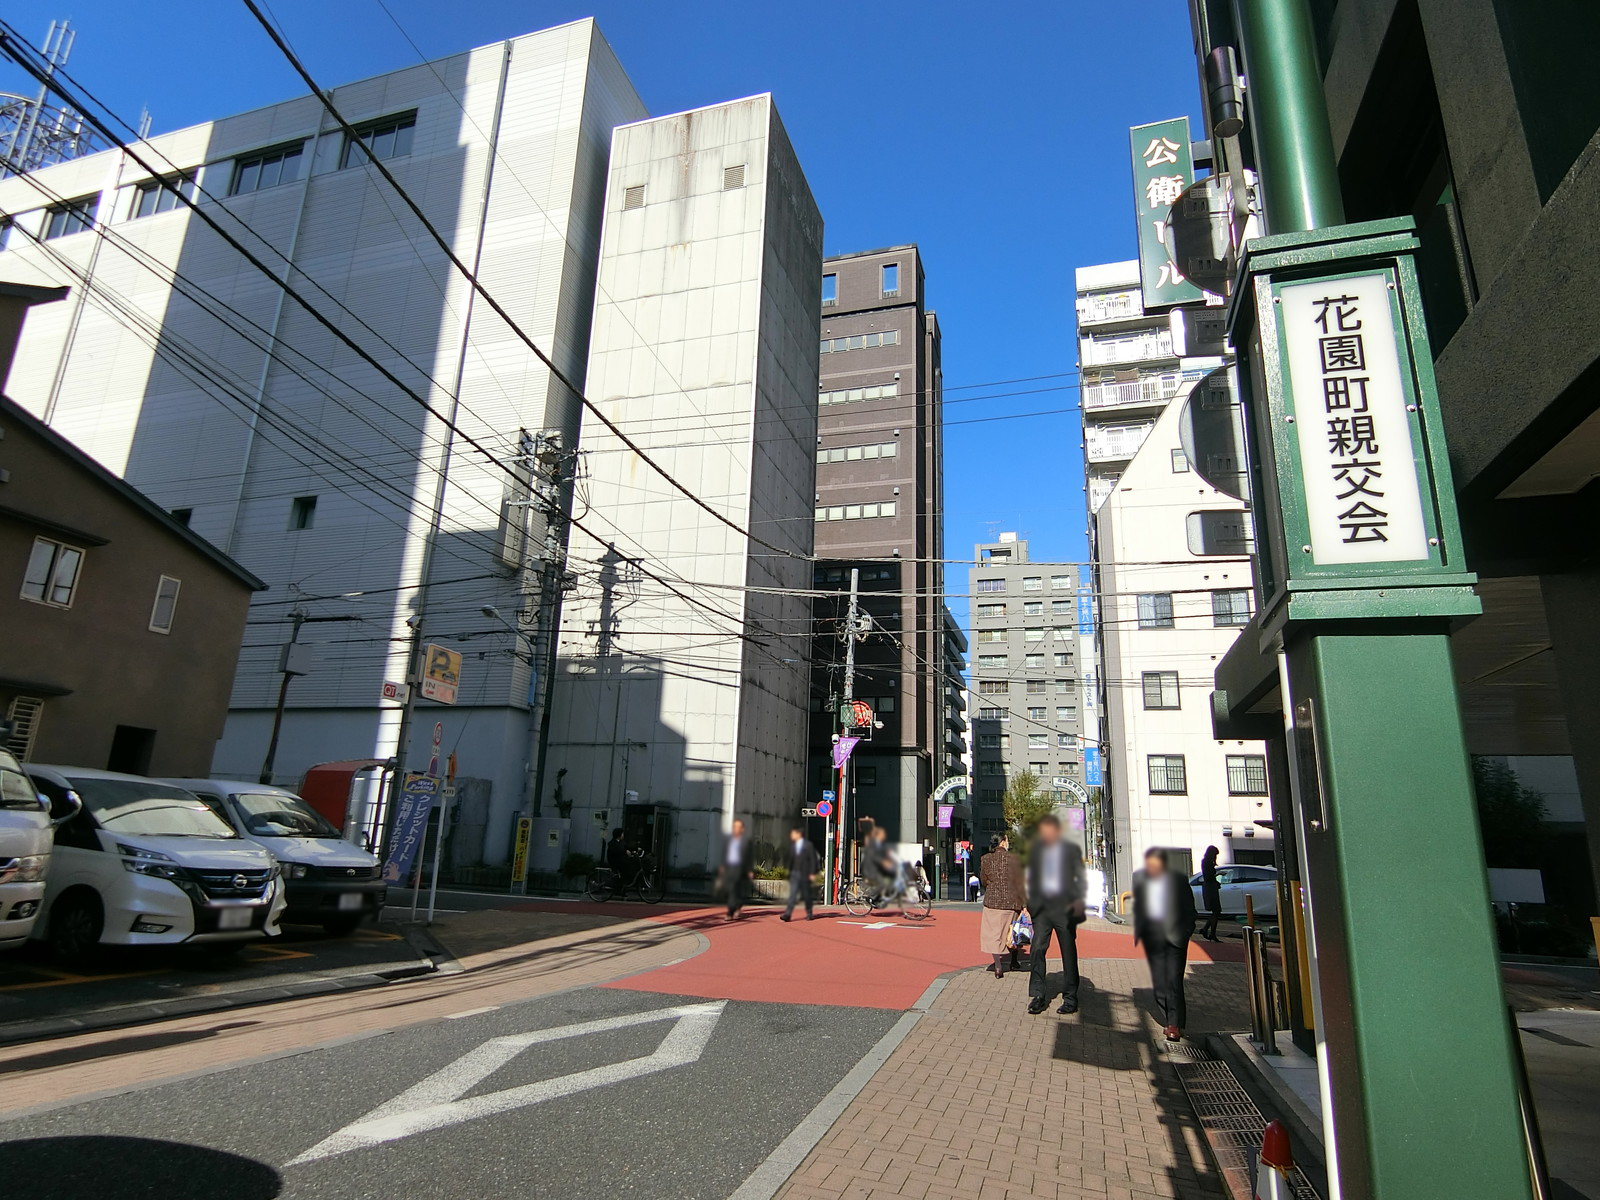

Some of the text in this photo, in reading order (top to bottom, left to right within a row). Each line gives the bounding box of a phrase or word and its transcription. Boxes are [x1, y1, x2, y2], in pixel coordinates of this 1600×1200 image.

[1312, 294, 1389, 544] 花園町親交会
[430, 648, 451, 676] P
[425, 681, 436, 689] IN
